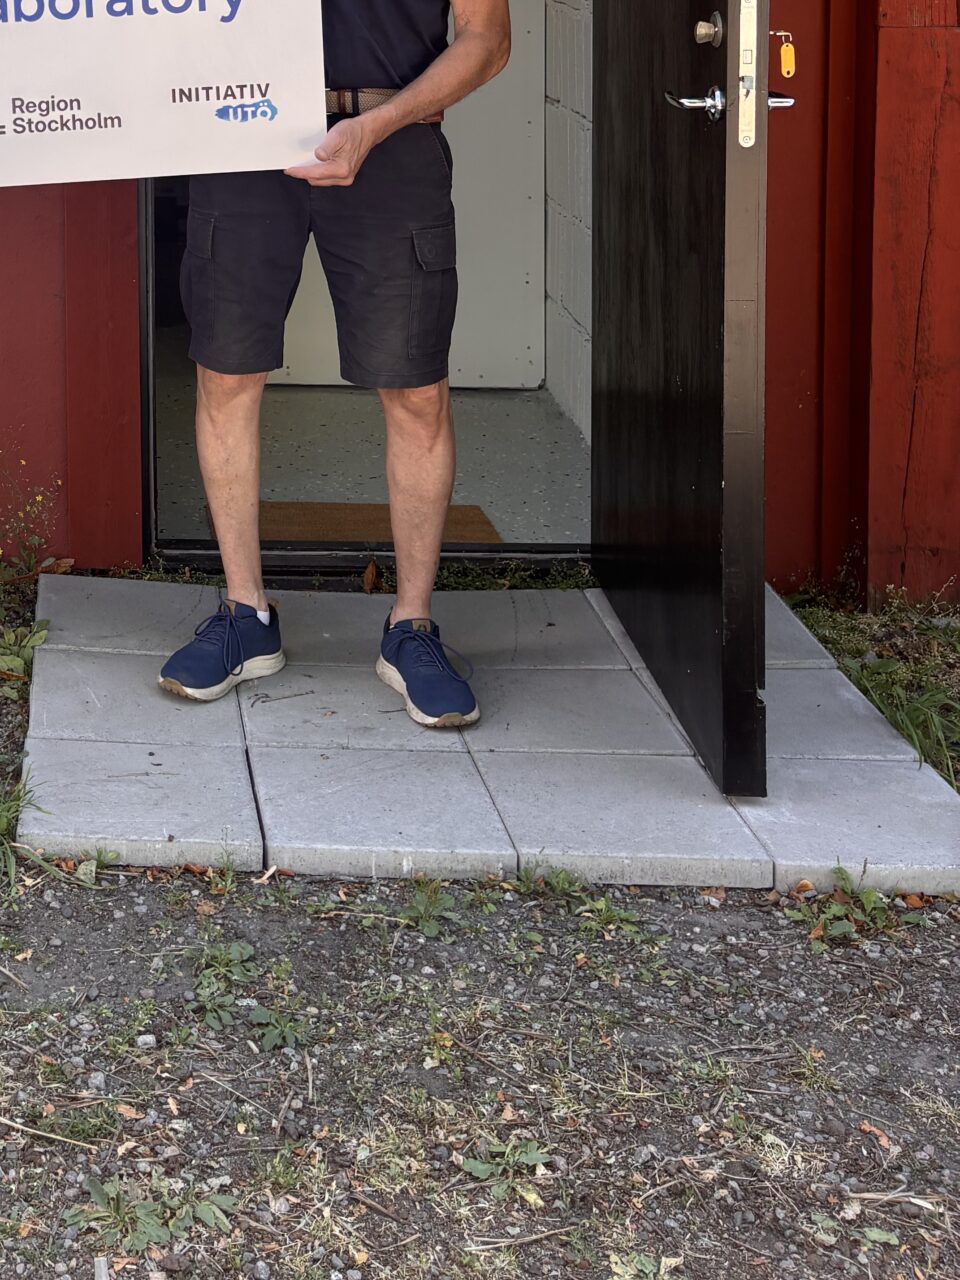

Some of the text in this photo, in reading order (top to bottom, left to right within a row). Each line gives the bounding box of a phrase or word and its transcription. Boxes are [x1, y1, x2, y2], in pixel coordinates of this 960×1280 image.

[171, 83, 270, 103] INITIATIV
[12, 95, 82, 117] Region
[228, 102, 272, 122] UTÖ
[12, 112, 122, 134] Stockholm
